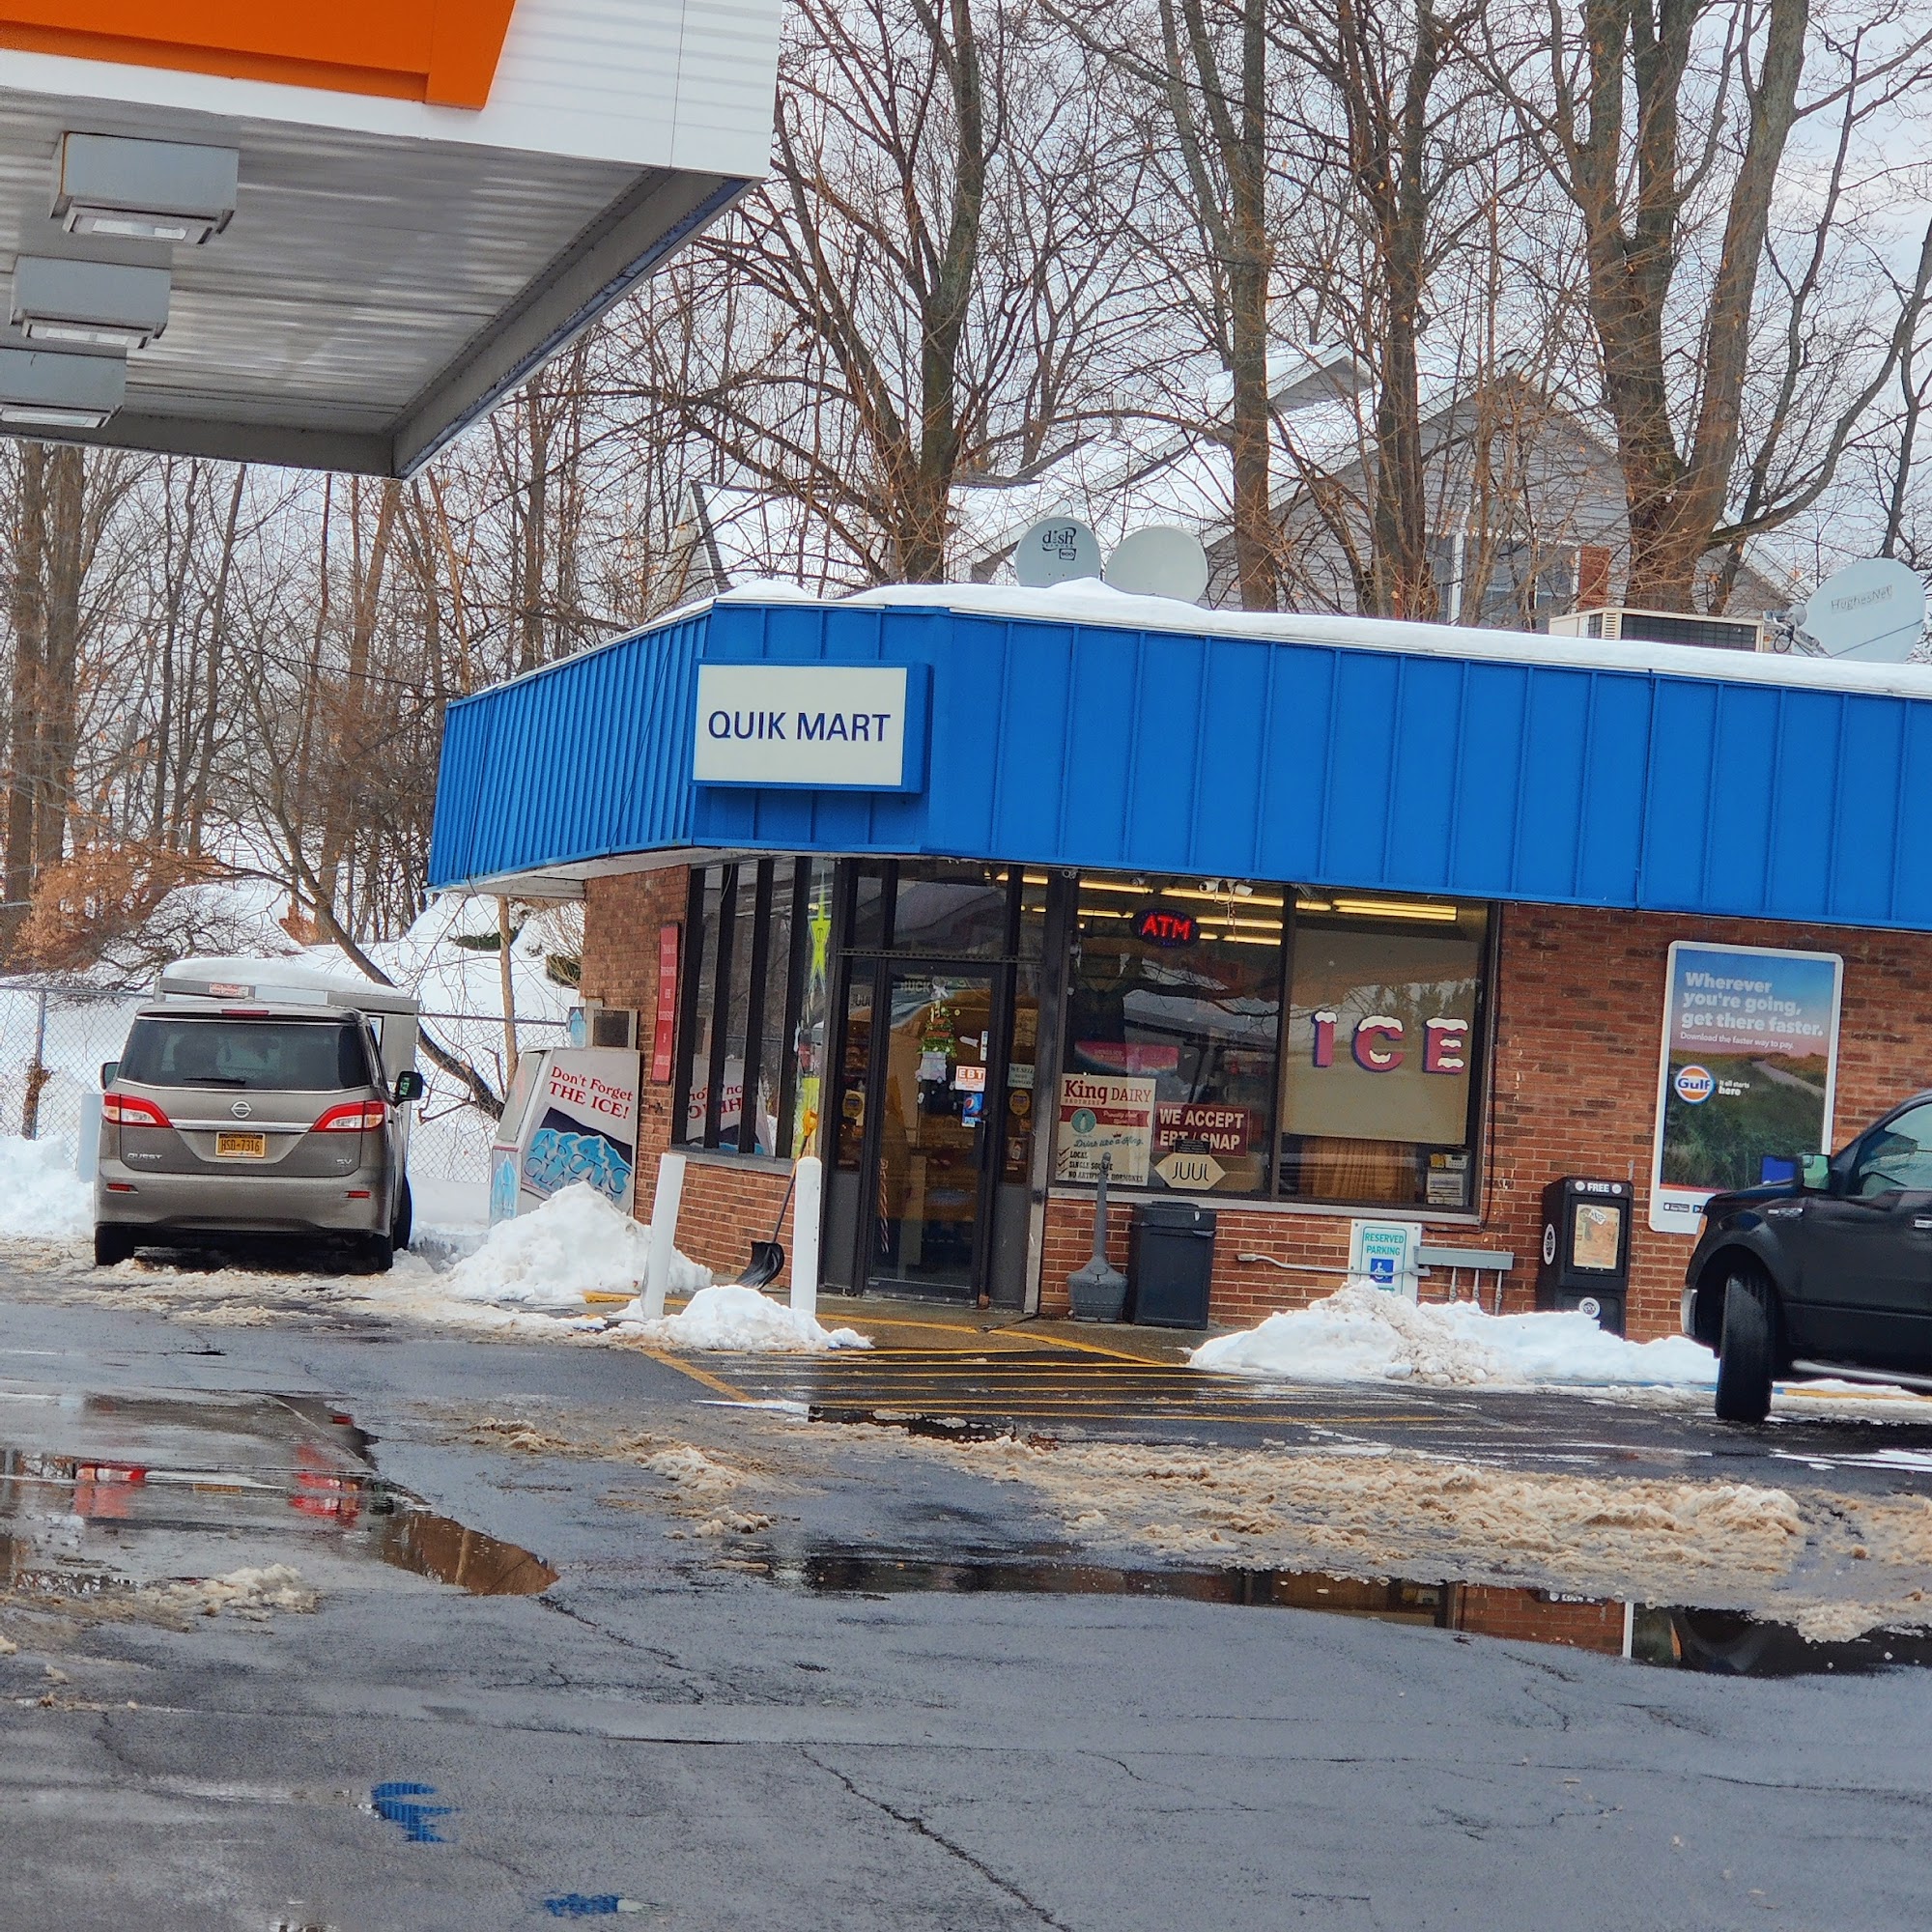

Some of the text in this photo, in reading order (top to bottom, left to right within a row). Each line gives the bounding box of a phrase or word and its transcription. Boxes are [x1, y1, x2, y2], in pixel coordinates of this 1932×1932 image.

[1042, 527, 1076, 545] dish
[1831, 584, 1893, 611] HughesNet
[708, 710, 891, 742] QUIK MART
[1141, 914, 1192, 941] ATM
[1685, 971, 1773, 994] Wherever
[1683, 992, 1803, 1017] you're going,
[1681, 1012, 1824, 1037] get there faster.
[1311, 1010, 1469, 1075] ICE
[1680, 1032, 1719, 1043] Download
[1719, 1035, 1731, 1043] the
[1733, 1036, 1754, 1046] faster
[1754, 1039, 1770, 1048] way
[1779, 1041, 1795, 1050] pay.
[551, 1065, 634, 1102] Don't Forget
[958, 1068, 983, 1079] EBT
[1678, 1077, 1711, 1090] Gulf
[549, 1081, 630, 1120] THE ICE!
[1064, 1080, 1151, 1105] King DAIRY
[1719, 1085, 1742, 1096] here
[1159, 1108, 1182, 1124] WE
[1184, 1110, 1244, 1129] ACCEPT
[1172, 1161, 1209, 1182] JUUL
[1587, 1182, 1610, 1193] FREE
[1365, 1233, 1405, 1244] RESERVED
[1366, 1245, 1401, 1256] PARKING
